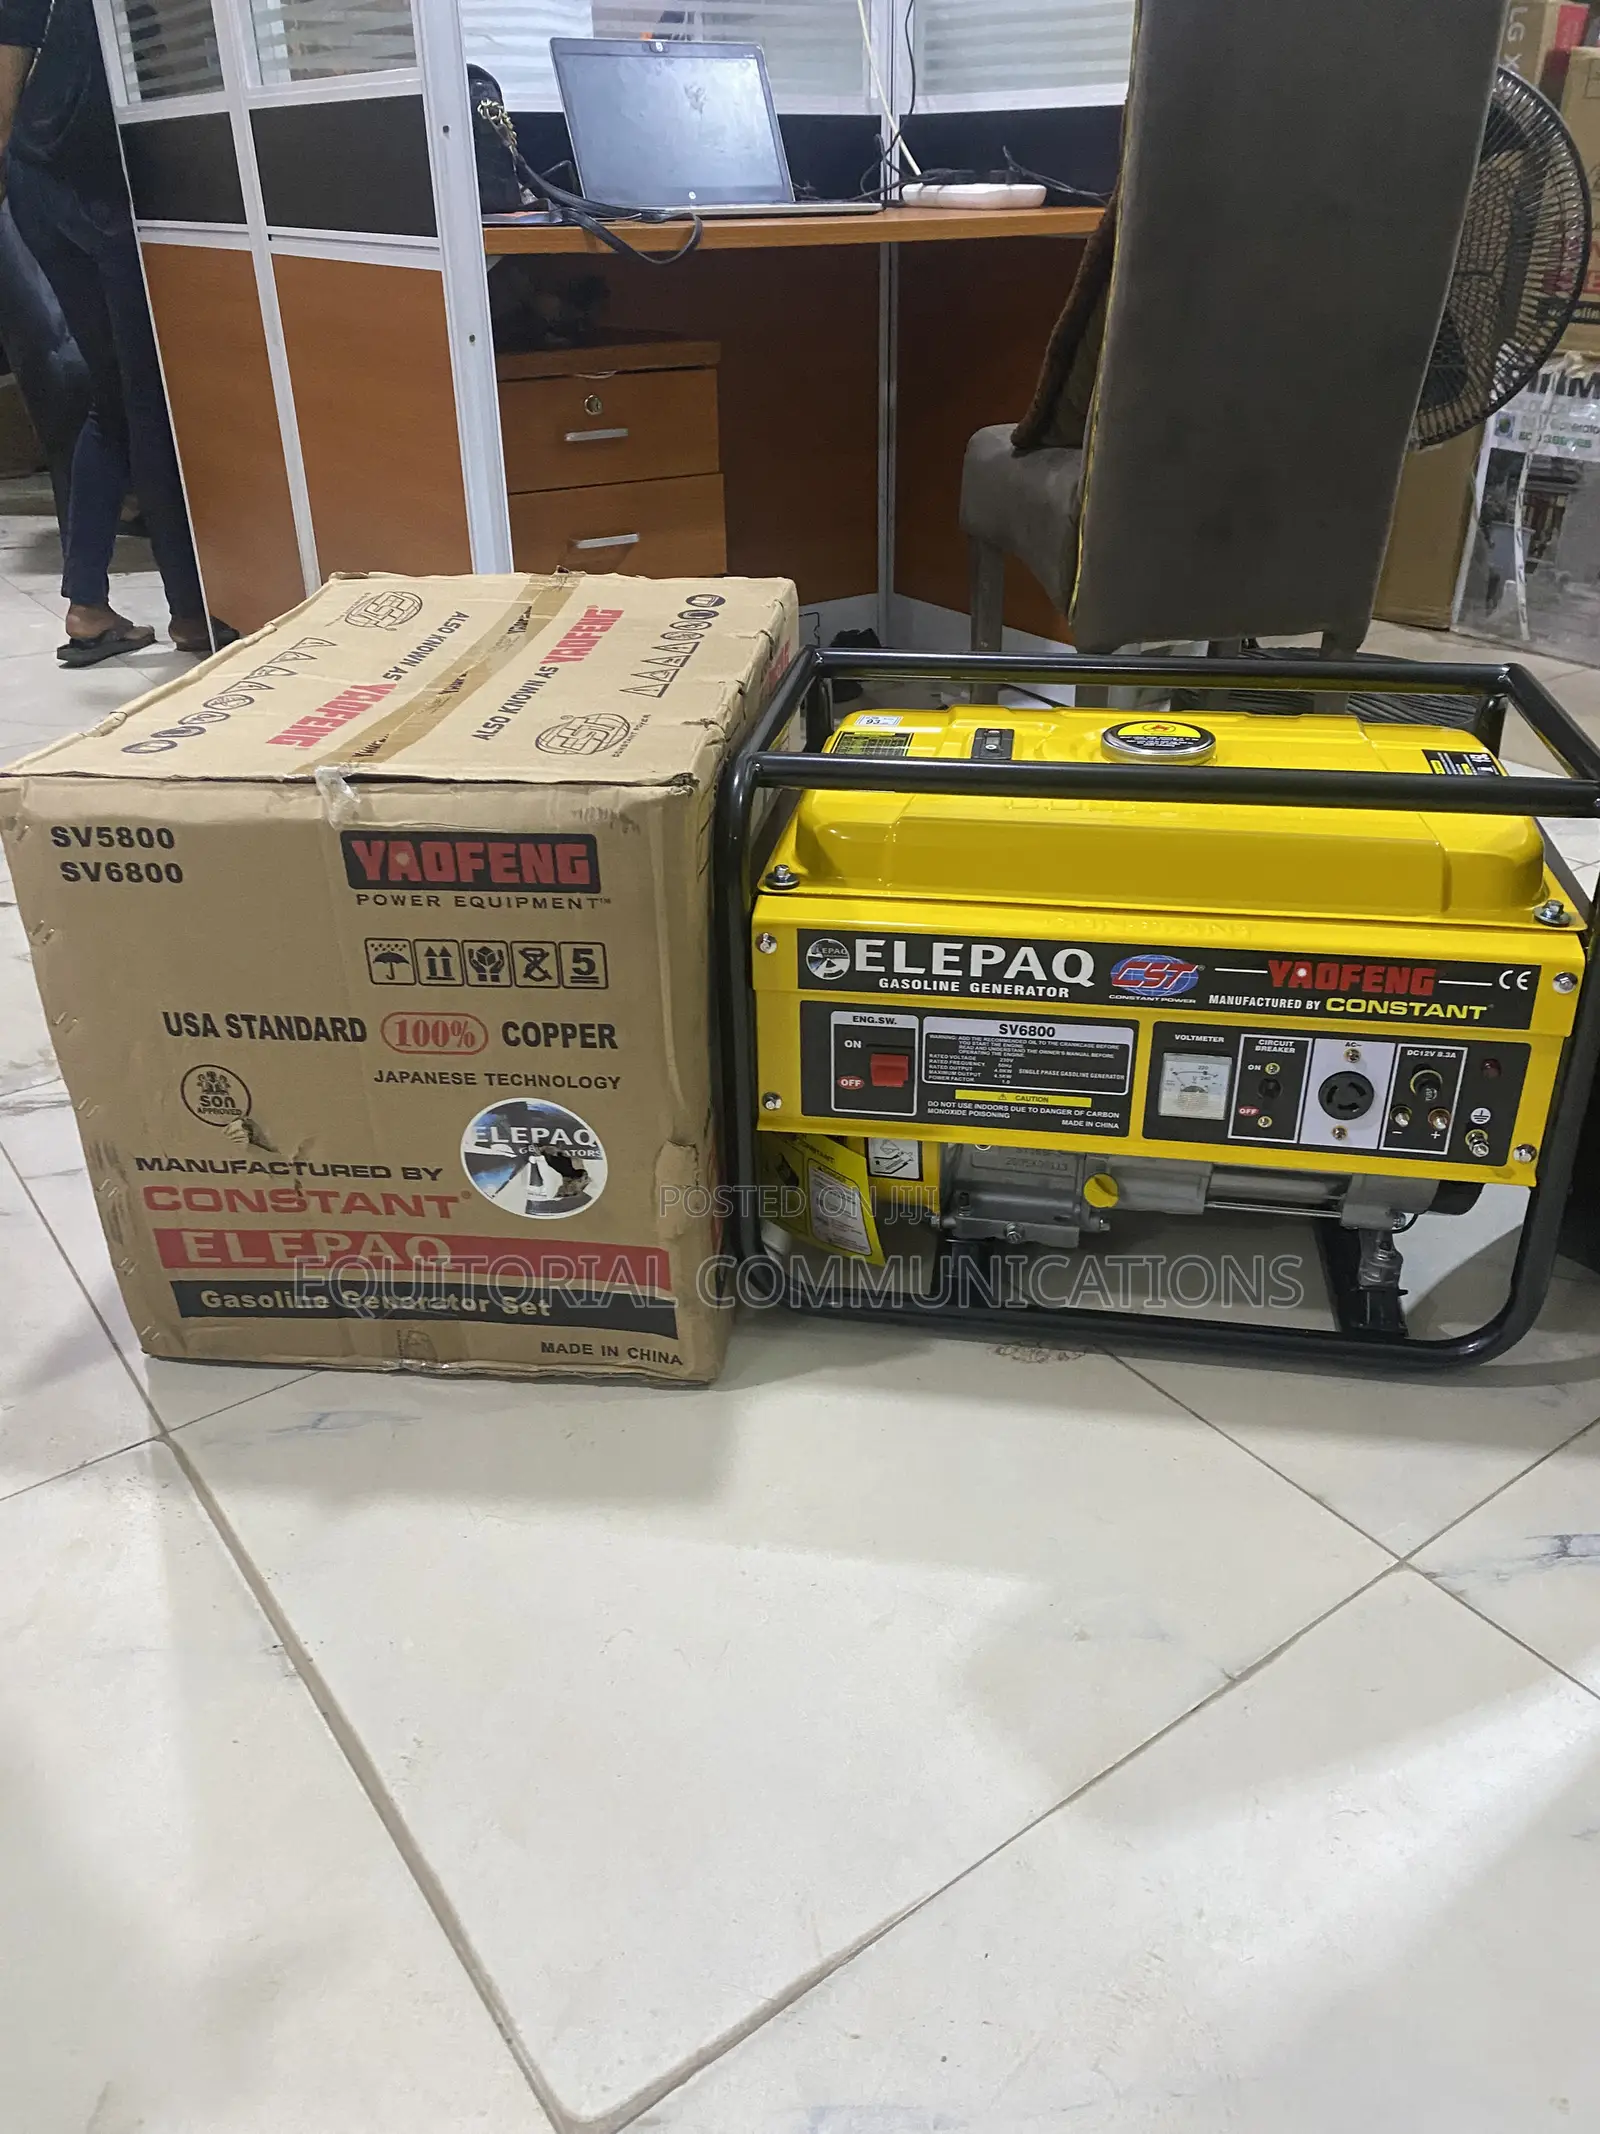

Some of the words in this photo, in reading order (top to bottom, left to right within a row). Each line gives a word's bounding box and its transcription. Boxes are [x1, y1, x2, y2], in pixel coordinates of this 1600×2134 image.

[439, 611, 470, 635] ALSO
[539, 608, 624, 665] YAOFENG
[404, 634, 446, 668] KNOWN
[382, 664, 409, 681] AS
[471, 714, 513, 741] ALSO
[501, 677, 549, 715] KNOWN
[539, 665, 560, 681] AS
[266, 682, 397, 750] YAOFENG
[50, 825, 176, 849] SV5800
[59, 861, 184, 884] SV6800
[350, 840, 592, 885] YAOFENG
[356, 894, 441, 908] POWER
[855, 938, 1096, 988] ELEPAQ
[1112, 961, 1198, 990] CST
[1268, 959, 1437, 997] YAOFENG
[878, 977, 960, 993] GASOLINE
[969, 980, 1070, 998] GENERATOR
[1108, 994, 1160, 1002] CONSTANT
[1208, 994, 1302, 1010] MANUFACTURED
[1305, 998, 1321, 1012] BY
[1325, 997, 1488, 1021] CONSTANT
[162, 1012, 221, 1039] USA
[226, 1013, 368, 1043] STANDARD
[394, 1020, 476, 1049] 100%
[501, 1021, 619, 1050] COPPER
[852, 1015, 898, 1026] ENG.SW.
[998, 1023, 1056, 1038] SV6800
[844, 1039, 862, 1049] ON
[1174, 1034, 1225, 1043] VOLTMETER
[1255, 1045, 1296, 1053] BREAKER
[1258, 1039, 1295, 1047] CIRCUIT
[1406, 1049, 1436, 1057] DC12V
[1436, 1051, 1457, 1059] 8.3A
[373, 1070, 477, 1086] JAPANESE
[484, 1073, 622, 1090] TECHNOLOGY
[840, 1077, 862, 1088] OFF
[1060, 1070, 1090, 1079] GASOLINE
[1090, 1072, 1126, 1081] GENERATOR
[1015, 1094, 1049, 1103] CAUTION
[197, 1107, 242, 1116] APPROVED
[927, 1107, 968, 1117] MONOXIDE
[968, 1110, 1011, 1119] POISONING
[973, 1103, 1009, 1112] INDOORS
[1010, 1105, 1027, 1113] DUE
[1040, 1107, 1073, 1116] DANGER
[1085, 1110, 1120, 1119] CARBON
[1239, 1107, 1258, 1115] OFF
[1061, 1119, 1084, 1127] MADE
[1085, 1120, 1094, 1128] IN
[1094, 1121, 1120, 1130] CHINA
[472, 1126, 598, 1148] ELEPAQ
[135, 1156, 391, 1180] MANUFACTURED
[402, 1163, 444, 1182] BY
[142, 1185, 460, 1220] CONSTANT
[183, 1230, 454, 1270] ELEPAQ
[200, 1289, 328, 1311] Gasoline
[340, 1289, 490, 1316] Generator
[501, 1296, 552, 1318] Set
[540, 1341, 596, 1357] MADE
[600, 1344, 619, 1359] IN
[626, 1346, 684, 1366] CHINA
